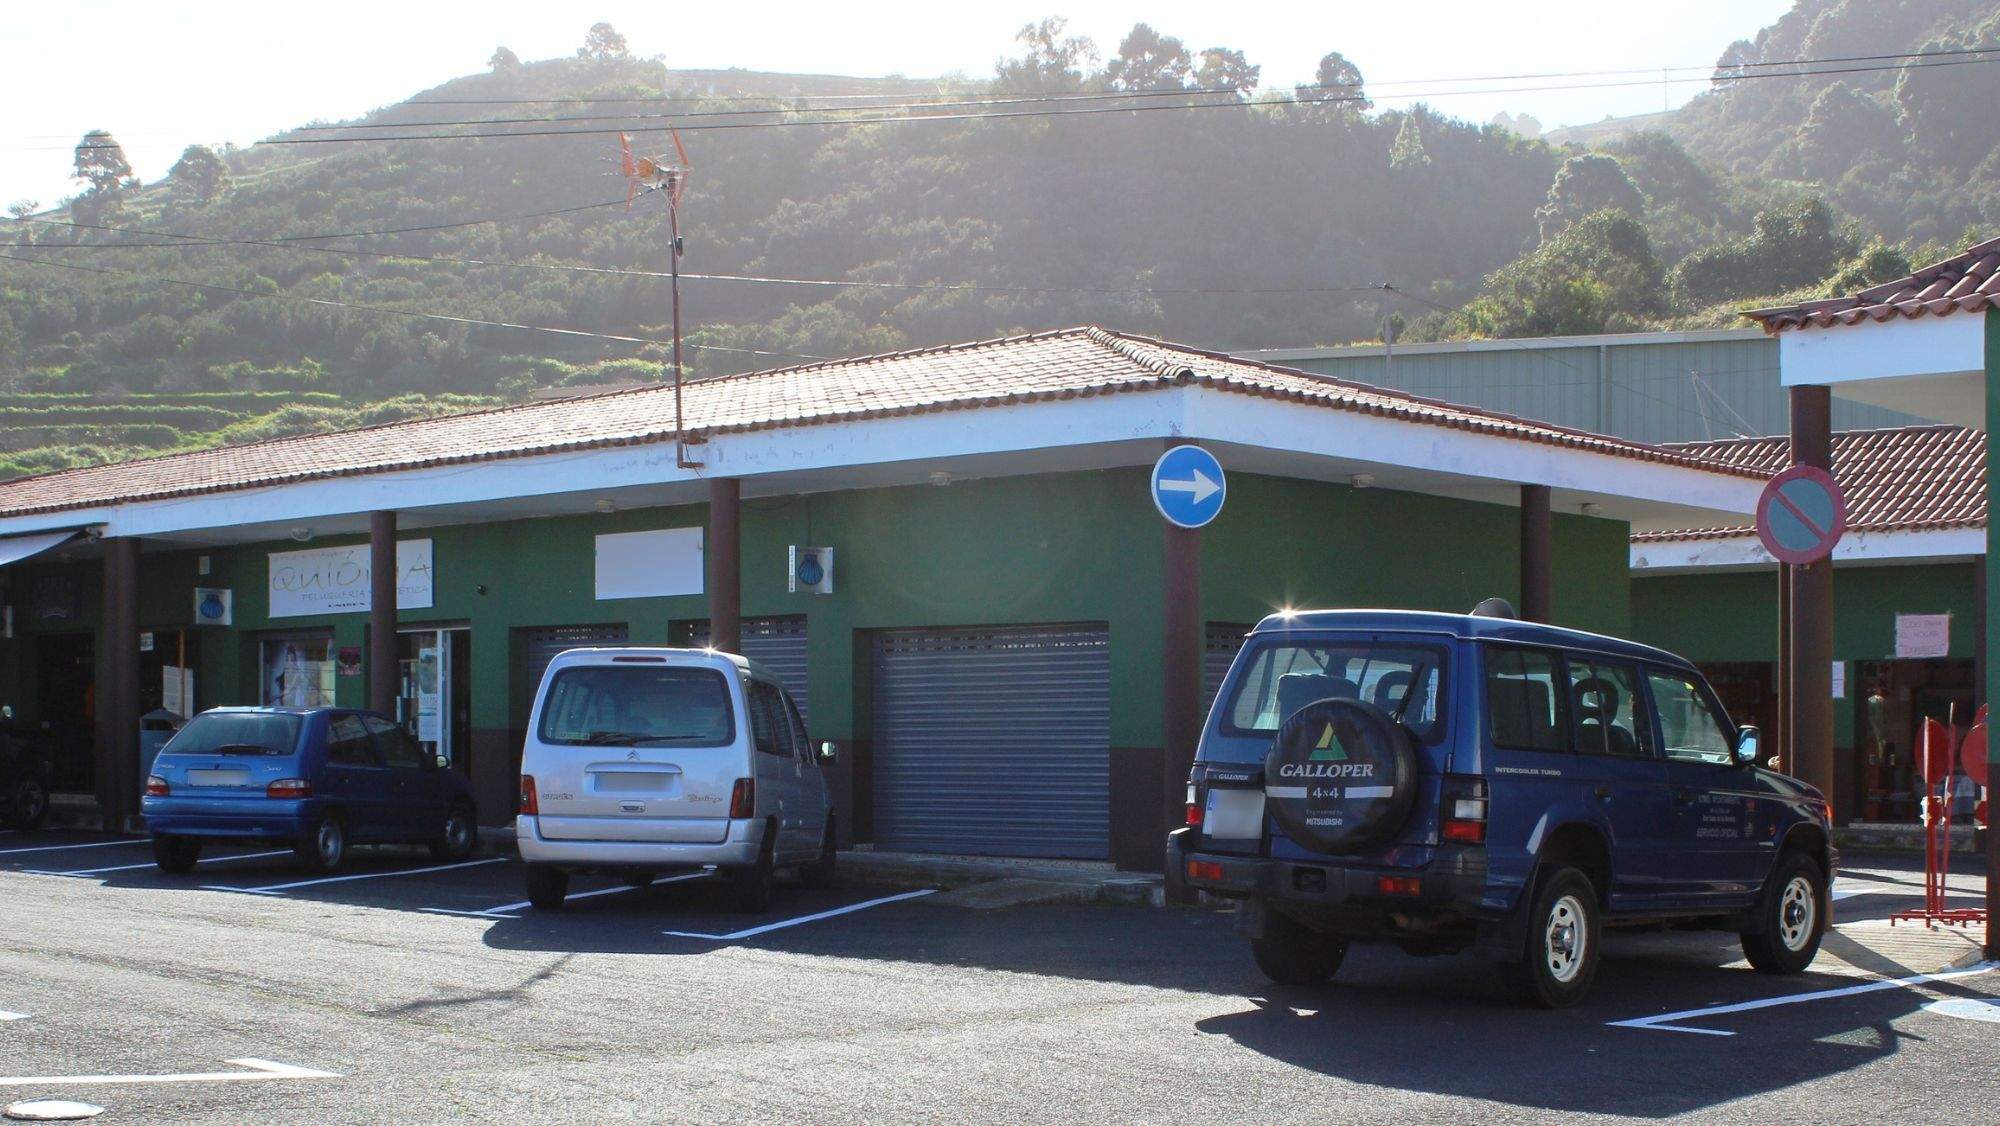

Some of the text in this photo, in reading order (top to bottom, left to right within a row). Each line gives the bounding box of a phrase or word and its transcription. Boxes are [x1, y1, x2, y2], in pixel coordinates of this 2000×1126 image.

[1280, 763, 1374, 779] GALLOPER
[1495, 766, 1539, 775] INTERCOOLER
[1218, 773, 1249, 781] GALLOPER
[1305, 817, 1343, 826] MITSUBISHI
